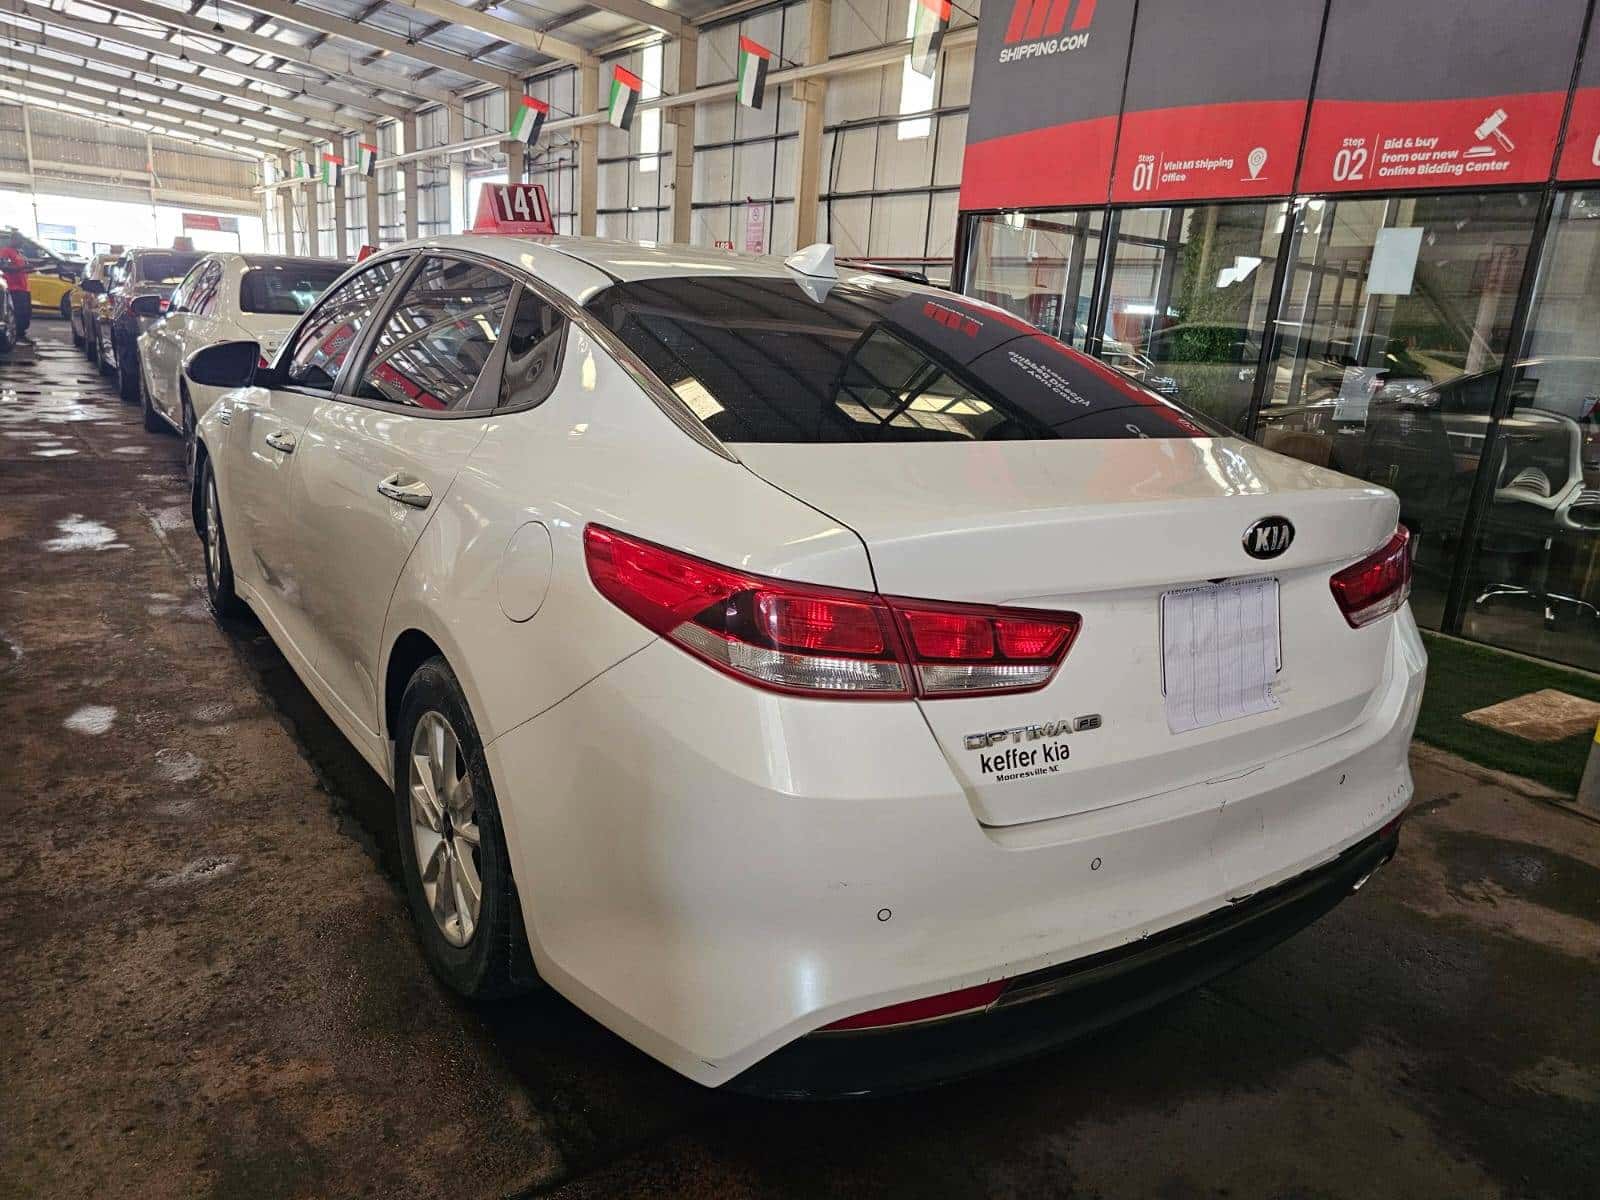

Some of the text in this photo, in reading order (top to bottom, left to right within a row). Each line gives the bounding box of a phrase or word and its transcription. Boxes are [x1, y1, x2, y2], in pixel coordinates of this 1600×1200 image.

[999, 33, 1090, 63] SHIPPING.COM
[1381, 150, 1459, 163] from our new
[1384, 137, 1439, 149] Bid & buy
[1132, 163, 1155, 192] 01
[1195, 157, 1234, 171] Shipping
[1333, 149, 1367, 181] 02
[1379, 160, 1510, 177] Online Bidding Center
[499, 186, 543, 222] 141
[1255, 525, 1289, 552] KIA
[964, 720, 1073, 751] OPTIMA
[980, 741, 1070, 774] keffer kia
[996, 768, 1048, 783] Mooresville
